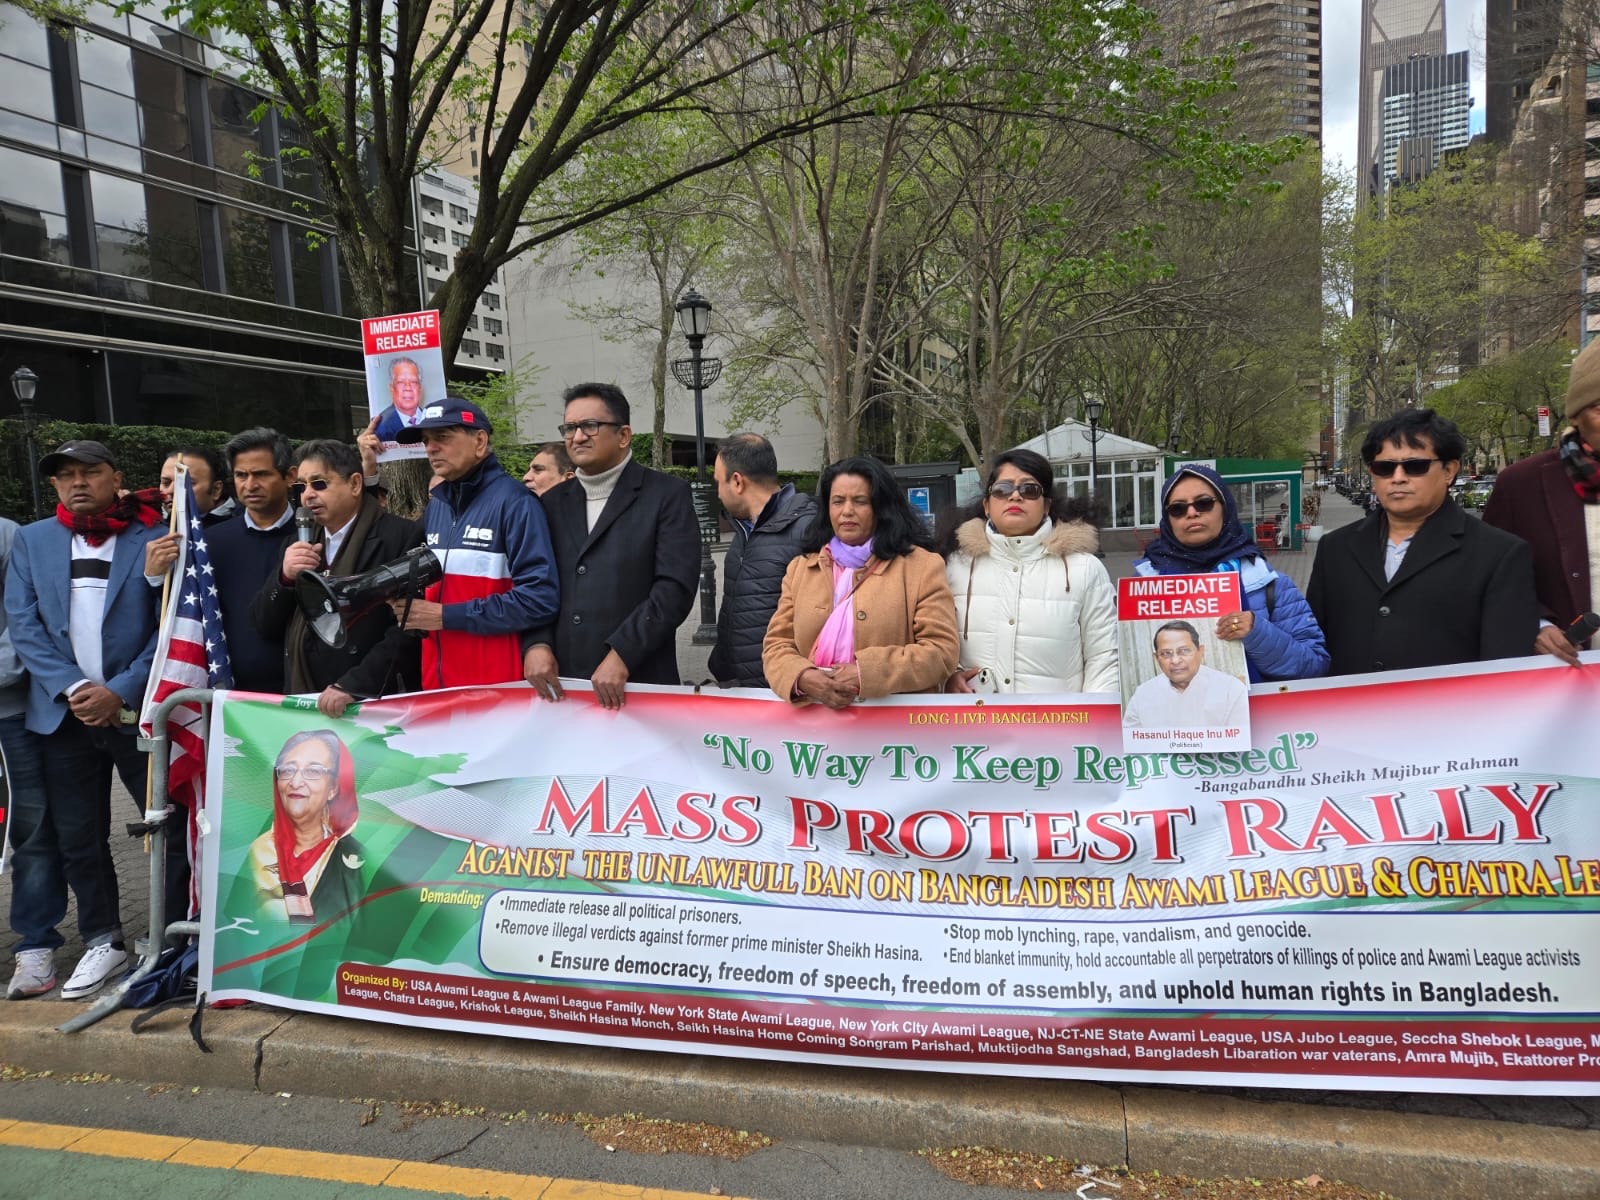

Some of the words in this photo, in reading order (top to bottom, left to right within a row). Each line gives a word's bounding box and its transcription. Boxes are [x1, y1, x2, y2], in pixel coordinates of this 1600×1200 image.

[370, 314, 434, 335] IMMEDIATE
[376, 333, 427, 351] RELEASE
[1129, 577, 1231, 597] IMMEDIATE
[1138, 598, 1218, 616] RELEASE
[908, 713, 950, 725] LONG
[954, 713, 986, 724] LIVE
[992, 712, 1088, 724] BANGLADESH
[1132, 730, 1170, 740] Hasanul
[1174, 730, 1204, 740] Haque
[1207, 729, 1222, 738] Inu
[1225, 728, 1240, 738] MP
[783, 741, 872, 786] Way
[881, 745, 939, 781] To
[952, 745, 1062, 789] Keep
[1310, 769, 1366, 786] Sheikh
[1372, 764, 1440, 782] Mujibur
[1446, 756, 1520, 772] Rahman
[533, 775, 762, 846] MASS
[786, 796, 1195, 864] PROTEST
[1216, 782, 1562, 860] RALLY
[457, 840, 574, 880] AGANIST
[583, 850, 632, 881] THE
[637, 852, 798, 893] UNLAWFULL
[803, 860, 864, 898] BAN
[868, 869, 915, 901] ON
[919, 868, 1116, 910] BANGLADESH
[1119, 874, 1226, 910] AWAMI
[1229, 862, 1367, 902] LEAGUE
[1371, 856, 1403, 899] &
[1407, 855, 1559, 898] CHATRA
[420, 886, 484, 910] Demanding:
[505, 896, 566, 914] Immediate
[568, 901, 610, 917] release
[612, 903, 626, 918] all
[629, 902, 676, 922] political
[679, 906, 742, 925] prisoners.
[500, 918, 549, 937] Remove
[552, 922, 588, 942] illegal
[590, 924, 636, 942] verdicts
[639, 927, 683, 947] against
[686, 928, 728, 948] former
[732, 934, 768, 952] prime
[771, 937, 824, 956] minister
[827, 940, 872, 959] Sheikh
[875, 943, 922, 962] Hasina.
[950, 923, 980, 943] Stop
[984, 925, 1014, 942] mob
[1017, 926, 1080, 948] lynching,
[1084, 931, 1118, 947] rape,
[1122, 926, 1200, 944] vandalism,
[1204, 922, 1232, 940] and
[1236, 920, 1312, 942] genocide.
[950, 947, 972, 965] End
[974, 948, 1016, 966] blanket
[1018, 952, 1073, 972] immunity,
[1076, 952, 1101, 968] hold
[1104, 949, 1176, 968] accountable
[1179, 948, 1194, 964] all
[1198, 948, 1274, 968] perpetrators
[1277, 947, 1290, 965] of
[1292, 947, 1338, 970] killings
[1342, 947, 1356, 966] of
[1358, 948, 1398, 970] police
[1400, 948, 1424, 966] and
[1428, 948, 1471, 967] Awami
[1474, 948, 1522, 970] League
[1526, 948, 1580, 967] activists
[550, 950, 610, 972] Ensure
[614, 955, 712, 983] democracy,
[718, 962, 794, 986] freedom
[800, 968, 818, 987] of
[824, 972, 896, 996] speech,
[902, 974, 980, 996] freedom
[987, 979, 1006, 997] of
[1012, 981, 1112, 1003] assembly,
[1119, 979, 1157, 1000] and
[1163, 979, 1235, 1004] uphold
[1241, 980, 1314, 1001] human
[1320, 980, 1386, 1006] rights
[1392, 982, 1412, 1002] in
[1419, 981, 1559, 1008] Bangladesh.
[342, 971, 390, 988] Organized
[392, 977, 408, 992] By:
[410, 980, 432, 992] USA
[434, 983, 468, 996] Awami
[472, 988, 510, 1003] League
[512, 991, 521, 1001] &
[523, 992, 560, 1006] Awami
[562, 996, 602, 1010] League
[649, 1004, 674, 1017] New
[678, 1006, 704, 1019] York
[708, 1008, 738, 1022] State
[741, 1011, 782, 1025] Awami
[786, 1014, 836, 1032] League,
[839, 1018, 866, 1031] New
[870, 1020, 898, 1033] York
[931, 1022, 976, 1037] Awami
[980, 1024, 1034, 1041] League,
[1038, 1027, 1104, 1040] NJ-CT-NE
[1108, 1029, 1144, 1041] State
[1148, 1030, 1196, 1042] Awami
[1200, 1030, 1258, 1046] League,
[1262, 1031, 1294, 1044] USA
[1298, 1031, 1334, 1044] Jubo
[1339, 1032, 1398, 1048] League,
[1402, 1032, 1456, 1045] Seccha
[1461, 1032, 1522, 1048] Shebok
[1526, 1034, 1587, 1050] League,
[344, 986, 382, 1001] League,
[384, 990, 415, 1004] Chatra
[418, 995, 458, 1010] League,
[460, 1000, 501, 1014] Krishok
[504, 1004, 546, 1019] League,
[549, 1009, 586, 1023] Sheikh
[590, 1012, 628, 1026] Hasina
[631, 1016, 674, 1031] Monch,
[677, 1020, 710, 1034] Seikh
[713, 1024, 755, 1038] Hasina
[758, 1028, 794, 1042] Home
[796, 1031, 846, 1048] Coming
[848, 1036, 908, 1051] Songram
[912, 1039, 974, 1054] Parishad,
[978, 1042, 1053, 1056] Muktijodha
[1057, 1044, 1130, 1060] Sangshad,
[1135, 1046, 1220, 1062] Bangladesh
[1302, 1050, 1327, 1062] war
[1332, 1050, 1400, 1064] vaterans,
[1404, 1051, 1446, 1064] Amra
[1450, 1051, 1499, 1068] Mujib,
[1502, 1053, 1575, 1066] Ekattorer
